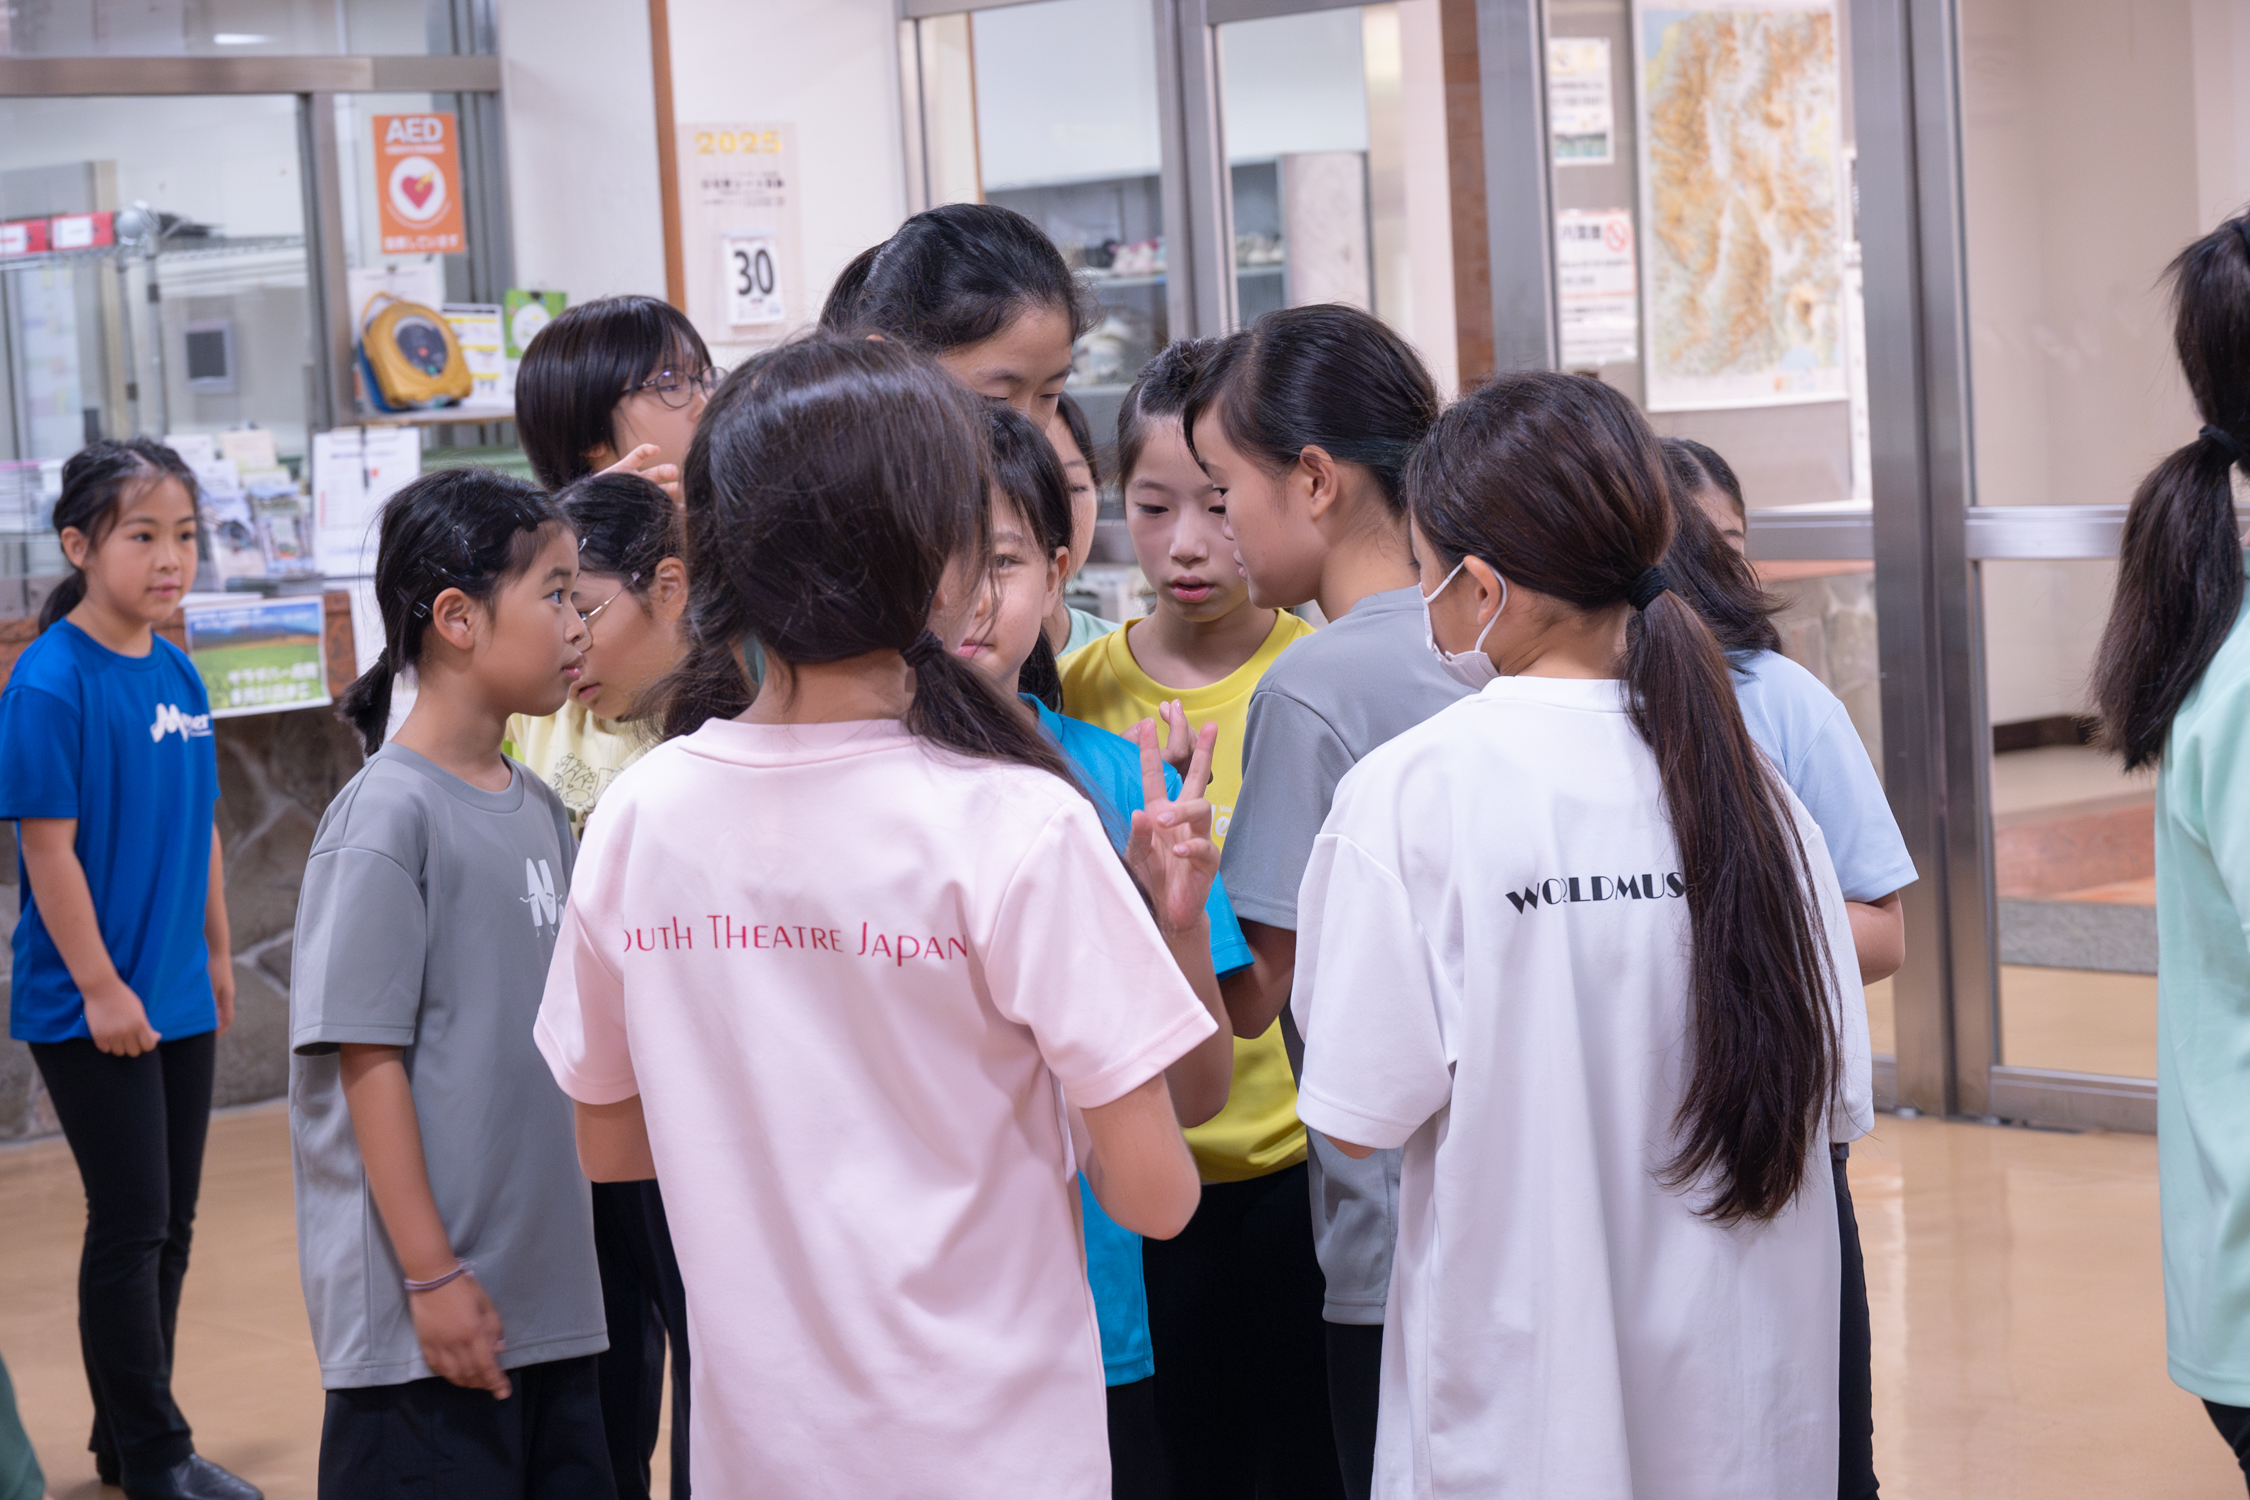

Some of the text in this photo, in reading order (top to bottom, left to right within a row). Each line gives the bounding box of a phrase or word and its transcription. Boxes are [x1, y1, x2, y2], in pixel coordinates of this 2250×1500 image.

[385, 117, 444, 144] AED
[695, 130, 782, 155] 2025
[733, 249, 774, 296] 30
